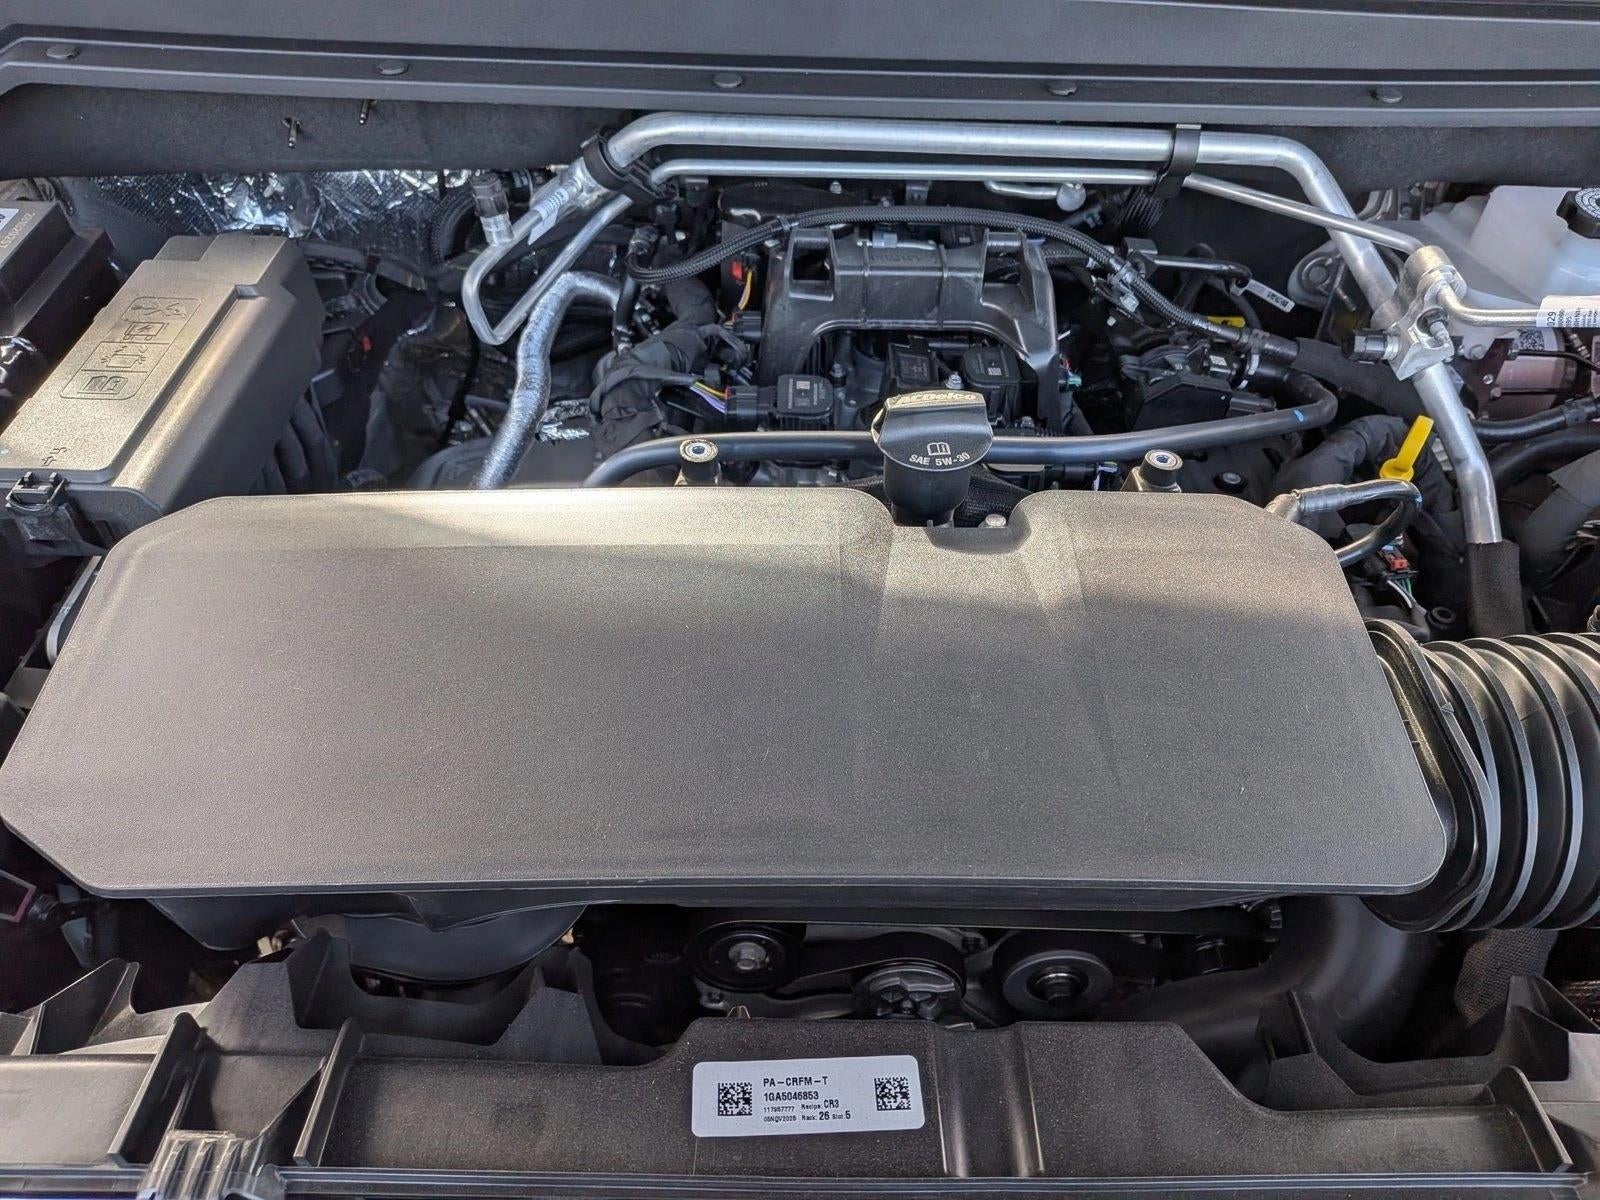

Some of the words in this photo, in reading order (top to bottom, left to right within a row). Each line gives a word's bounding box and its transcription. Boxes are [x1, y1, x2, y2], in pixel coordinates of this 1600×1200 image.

[909, 454, 930, 466] SAE
[935, 452, 970, 467] 5W-30
[764, 1090, 819, 1102] 1GA5046853
[823, 1099, 839, 1108] CR3
[818, 1111, 830, 1120] 26
[845, 1110, 851, 1120] 5
